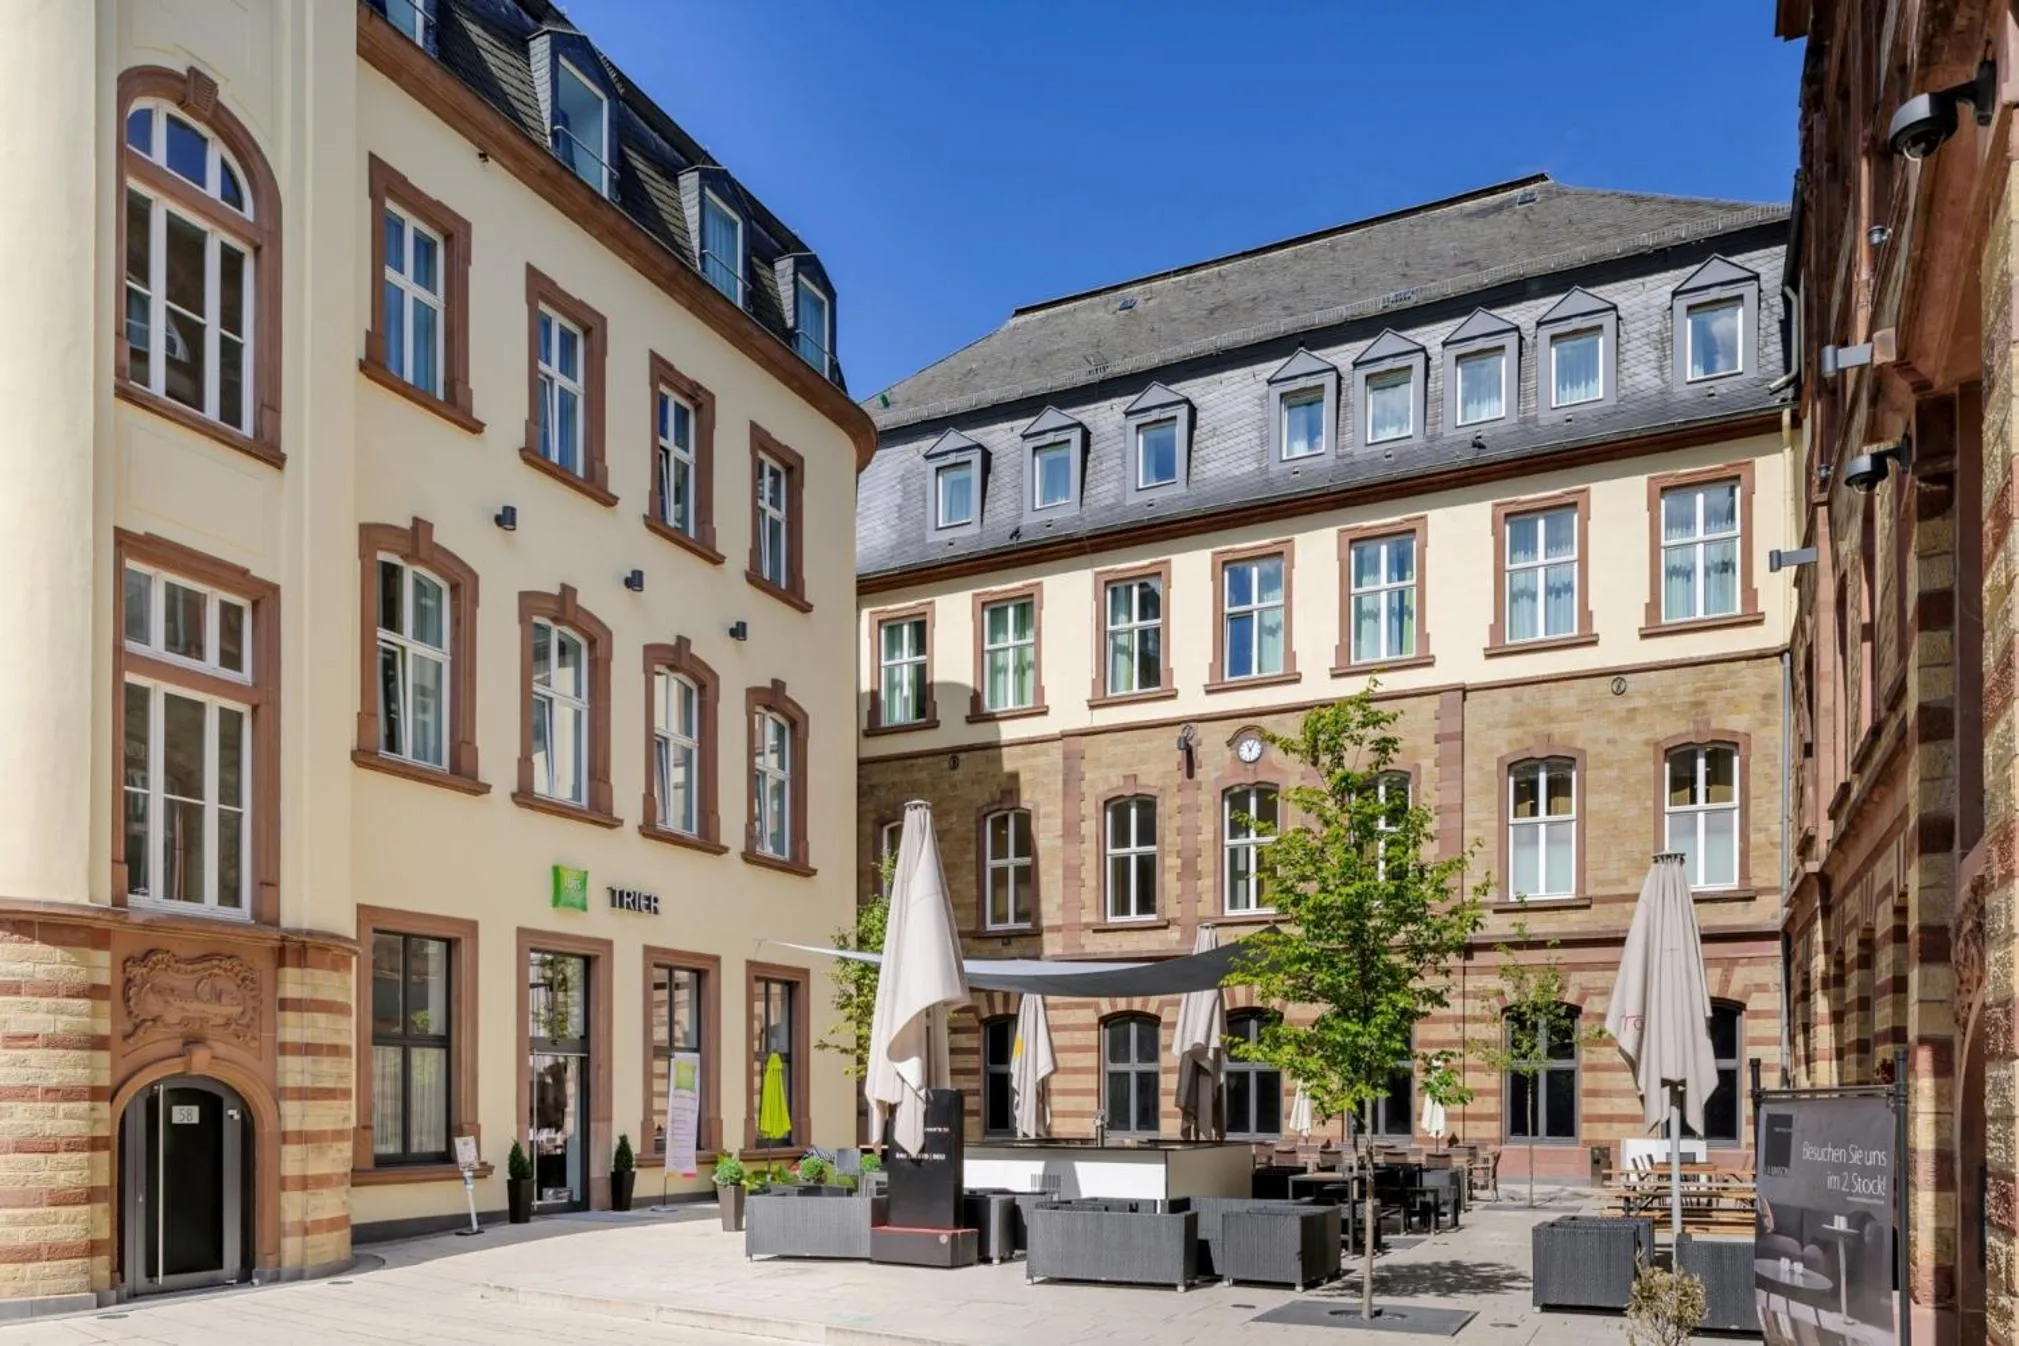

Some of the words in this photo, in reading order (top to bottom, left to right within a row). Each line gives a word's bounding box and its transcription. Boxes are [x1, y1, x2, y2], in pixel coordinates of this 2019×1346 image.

[607, 886, 660, 914] TRIER
[179, 1108, 193, 1121] 58
[1802, 1141, 1847, 1164] Besuchen
[1848, 1143, 1863, 1166] Sie
[1864, 1149, 1887, 1168] uns
[1827, 1170, 1840, 1191] im
[1851, 1172, 1887, 1197] Stock!
